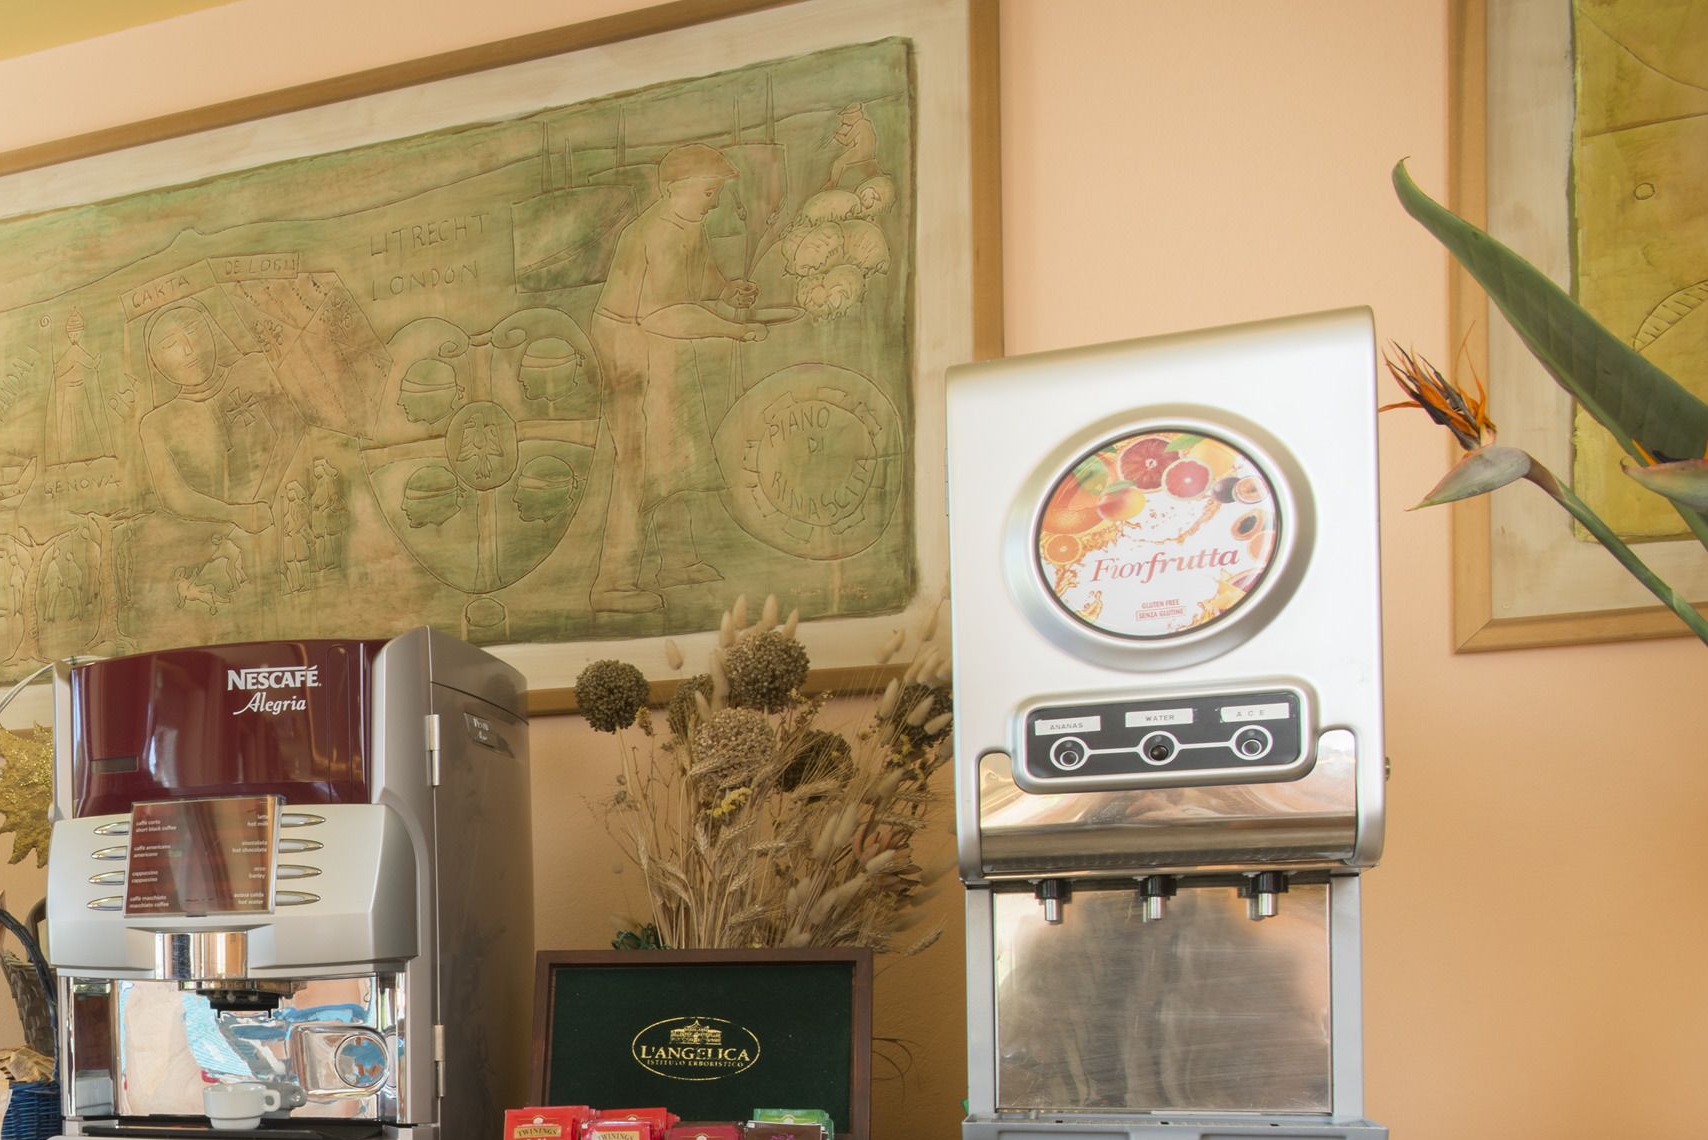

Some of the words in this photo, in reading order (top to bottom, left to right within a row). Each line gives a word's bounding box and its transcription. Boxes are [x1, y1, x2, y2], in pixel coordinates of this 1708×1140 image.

[224, 260, 241, 276] DE
[371, 260, 478, 302] LONDON
[767, 405, 831, 448] PIANO
[807, 436, 825, 453] DI
[44, 474, 121, 499] GENOVA
[1091, 548, 1240, 584] Fiorfrutta
[1141, 600, 1164, 610] GLUTEN
[1165, 599, 1181, 607] FREE
[1138, 611, 1158, 620] SENZA
[1159, 608, 1184, 617] GLUTINE
[227, 664, 320, 691] NESCAFÉ
[232, 691, 307, 716] Alegria
[1049, 722, 1084, 731] ANANAS
[1145, 714, 1175, 722] WATER
[640, 1045, 751, 1062] L'ANGELICA
[516, 1126, 558, 1136] TWININGS
